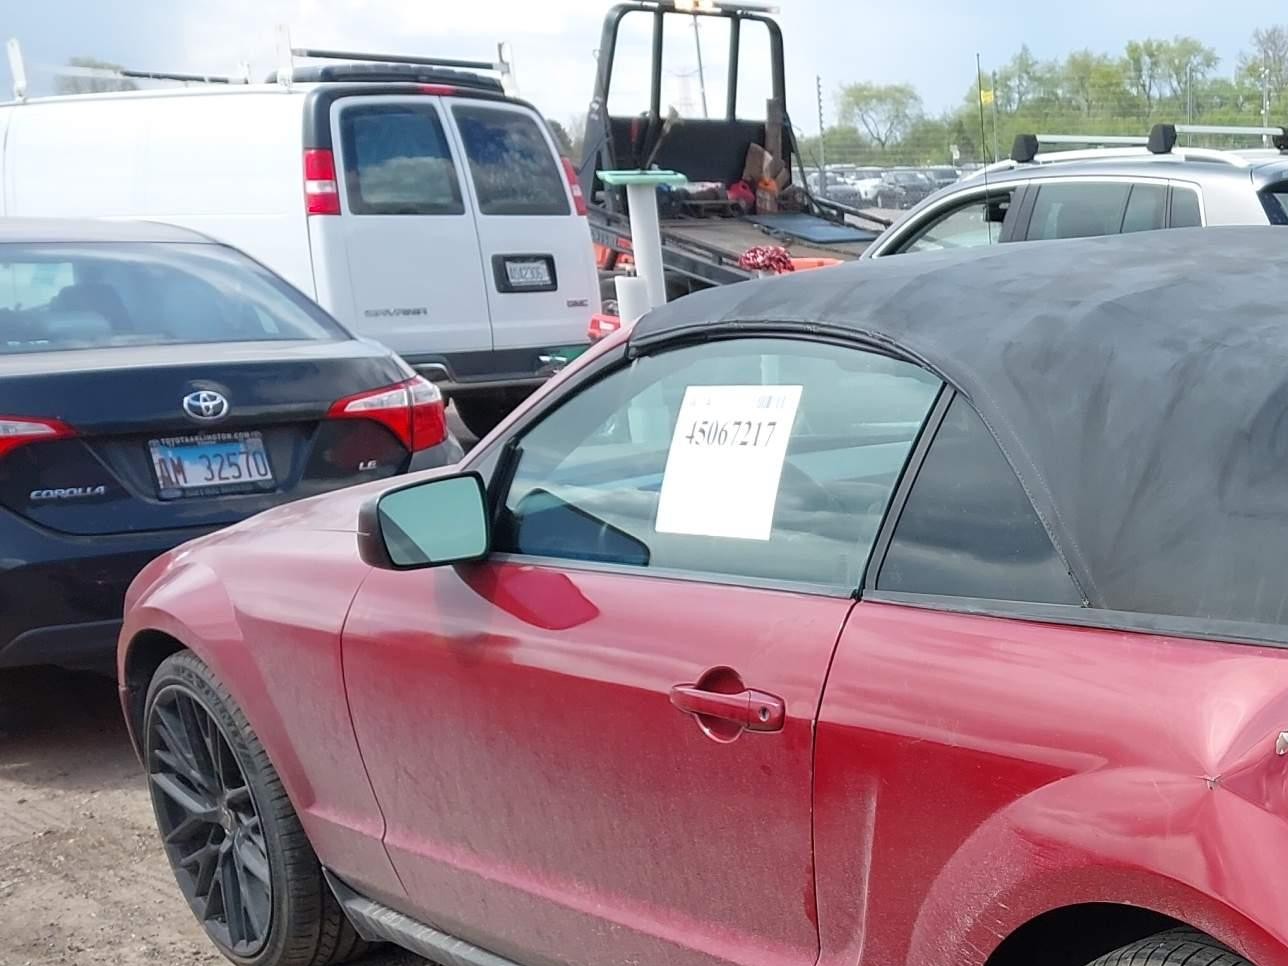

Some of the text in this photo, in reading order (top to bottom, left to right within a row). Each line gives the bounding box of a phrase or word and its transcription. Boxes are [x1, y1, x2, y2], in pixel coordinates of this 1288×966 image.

[685, 421, 777, 447] 45067217
[198, 451, 268, 481] 32570
[358, 460, 377, 471] LE
[30, 484, 105, 501] COROLLA
